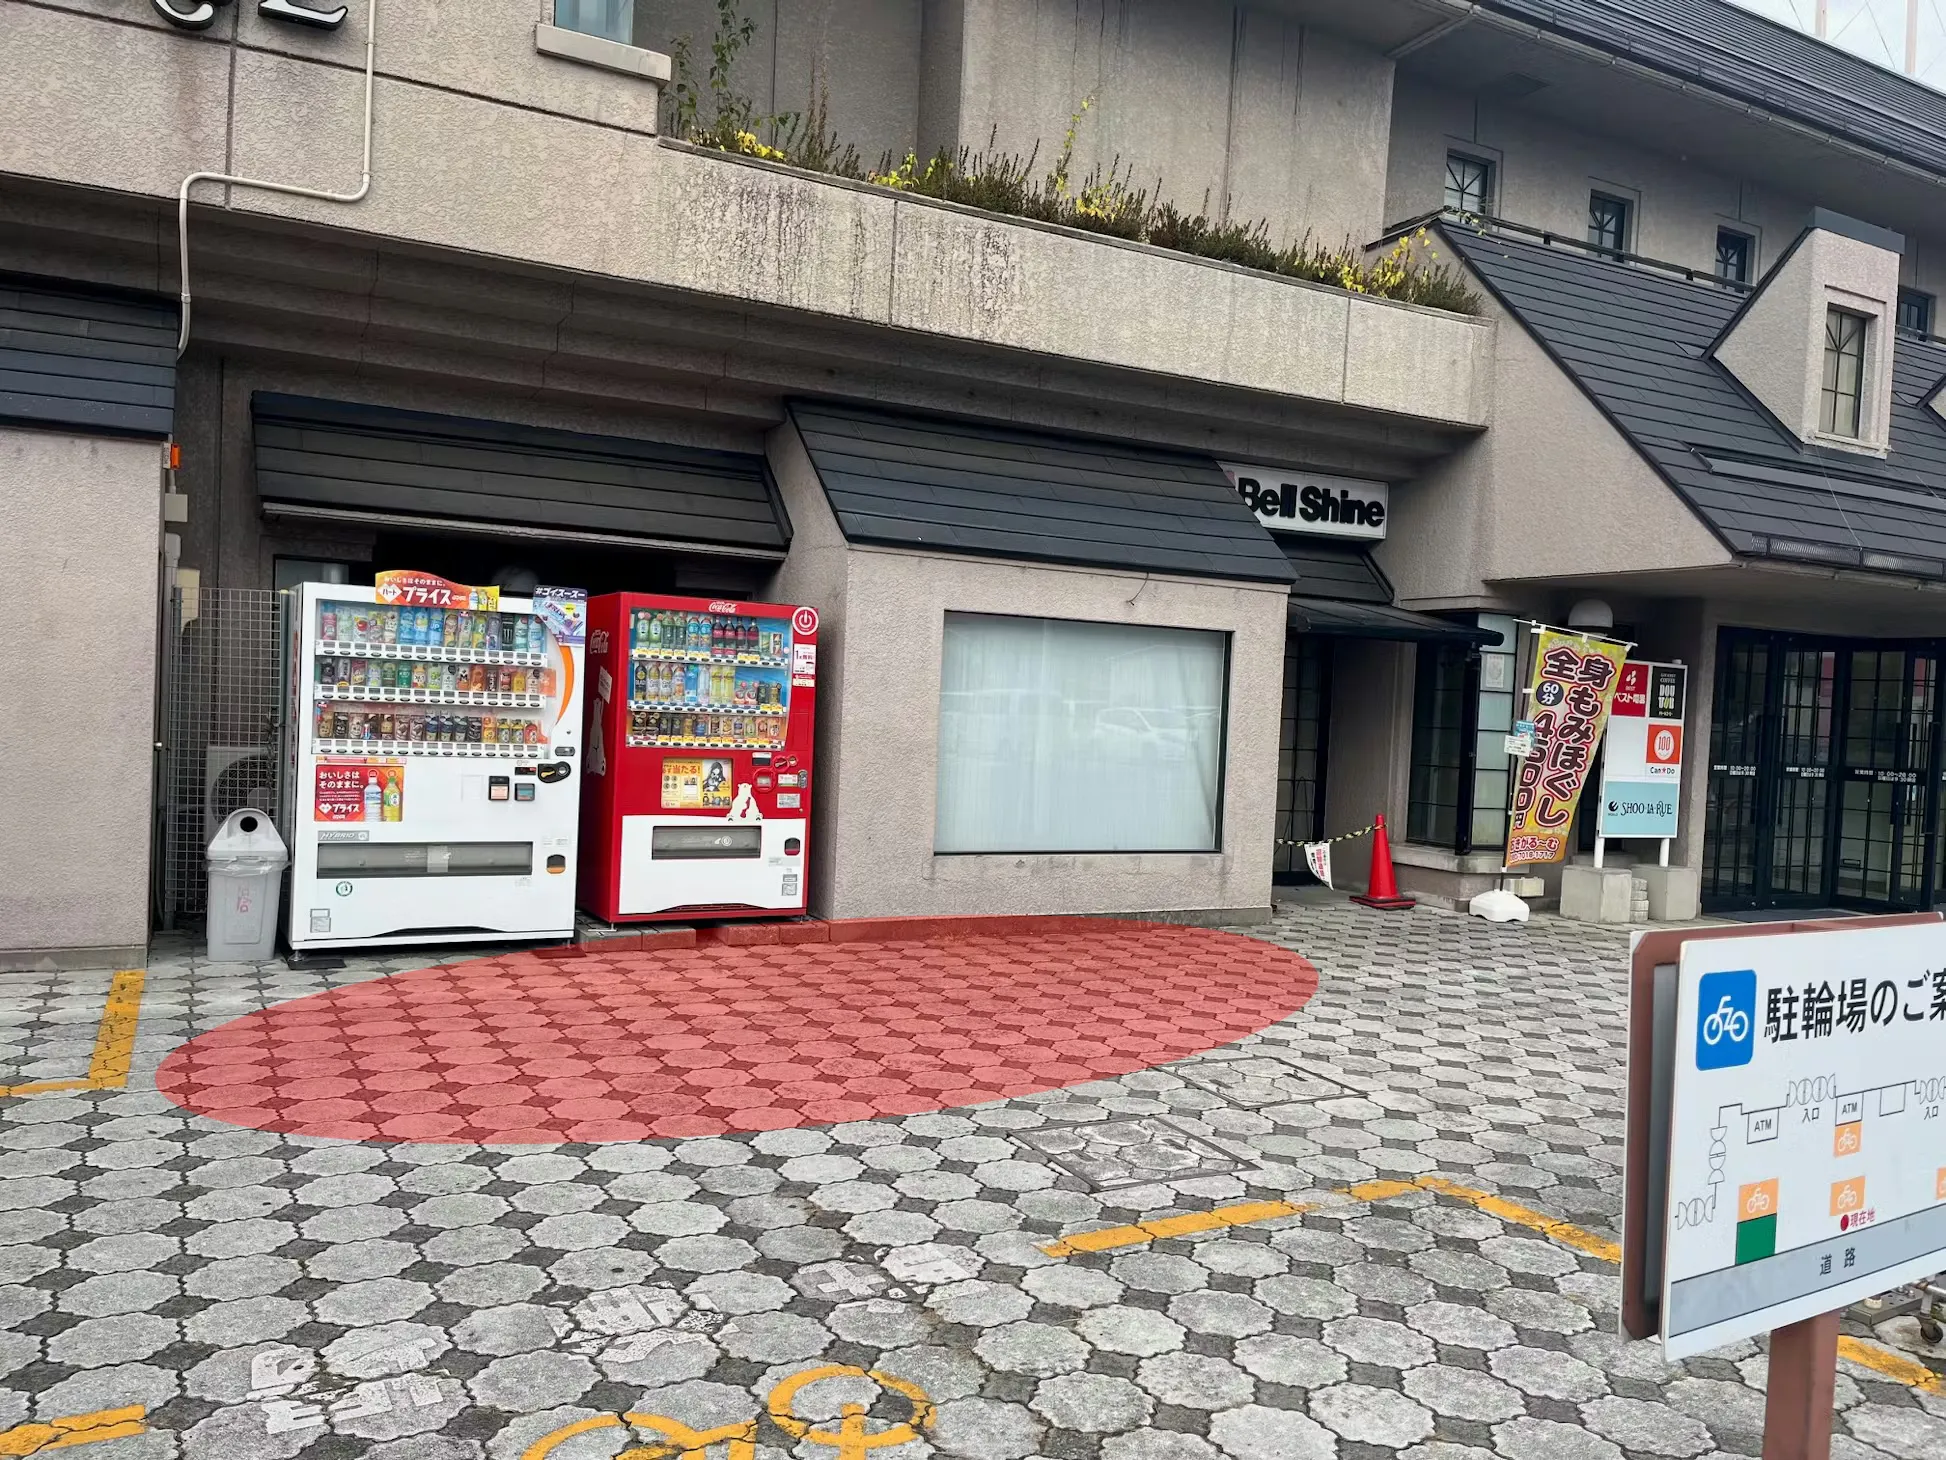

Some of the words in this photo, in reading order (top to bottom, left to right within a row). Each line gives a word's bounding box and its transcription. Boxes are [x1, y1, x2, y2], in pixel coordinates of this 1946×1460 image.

[1238, 477, 1297, 519] Bell
[1299, 485, 1386, 527] Shine
[402, 585, 452, 606] プライス
[535, 587, 586, 599] #ゴイスースー
[1541, 648, 1616, 690] 全身
[1658, 736, 1671, 751] 100
[1536, 686, 1602, 826] もみほぐし
[319, 771, 360, 779] おいしさは
[319, 780, 364, 789] そのままに。
[332, 803, 360, 813] プライス
[1802, 1107, 1820, 1123] 入口
[1842, 1102, 1858, 1115] ATM
[1924, 1106, 1939, 1121] 入口
[1754, 1118, 1772, 1132] ATM
[1850, 1208, 1876, 1228] 現在地
